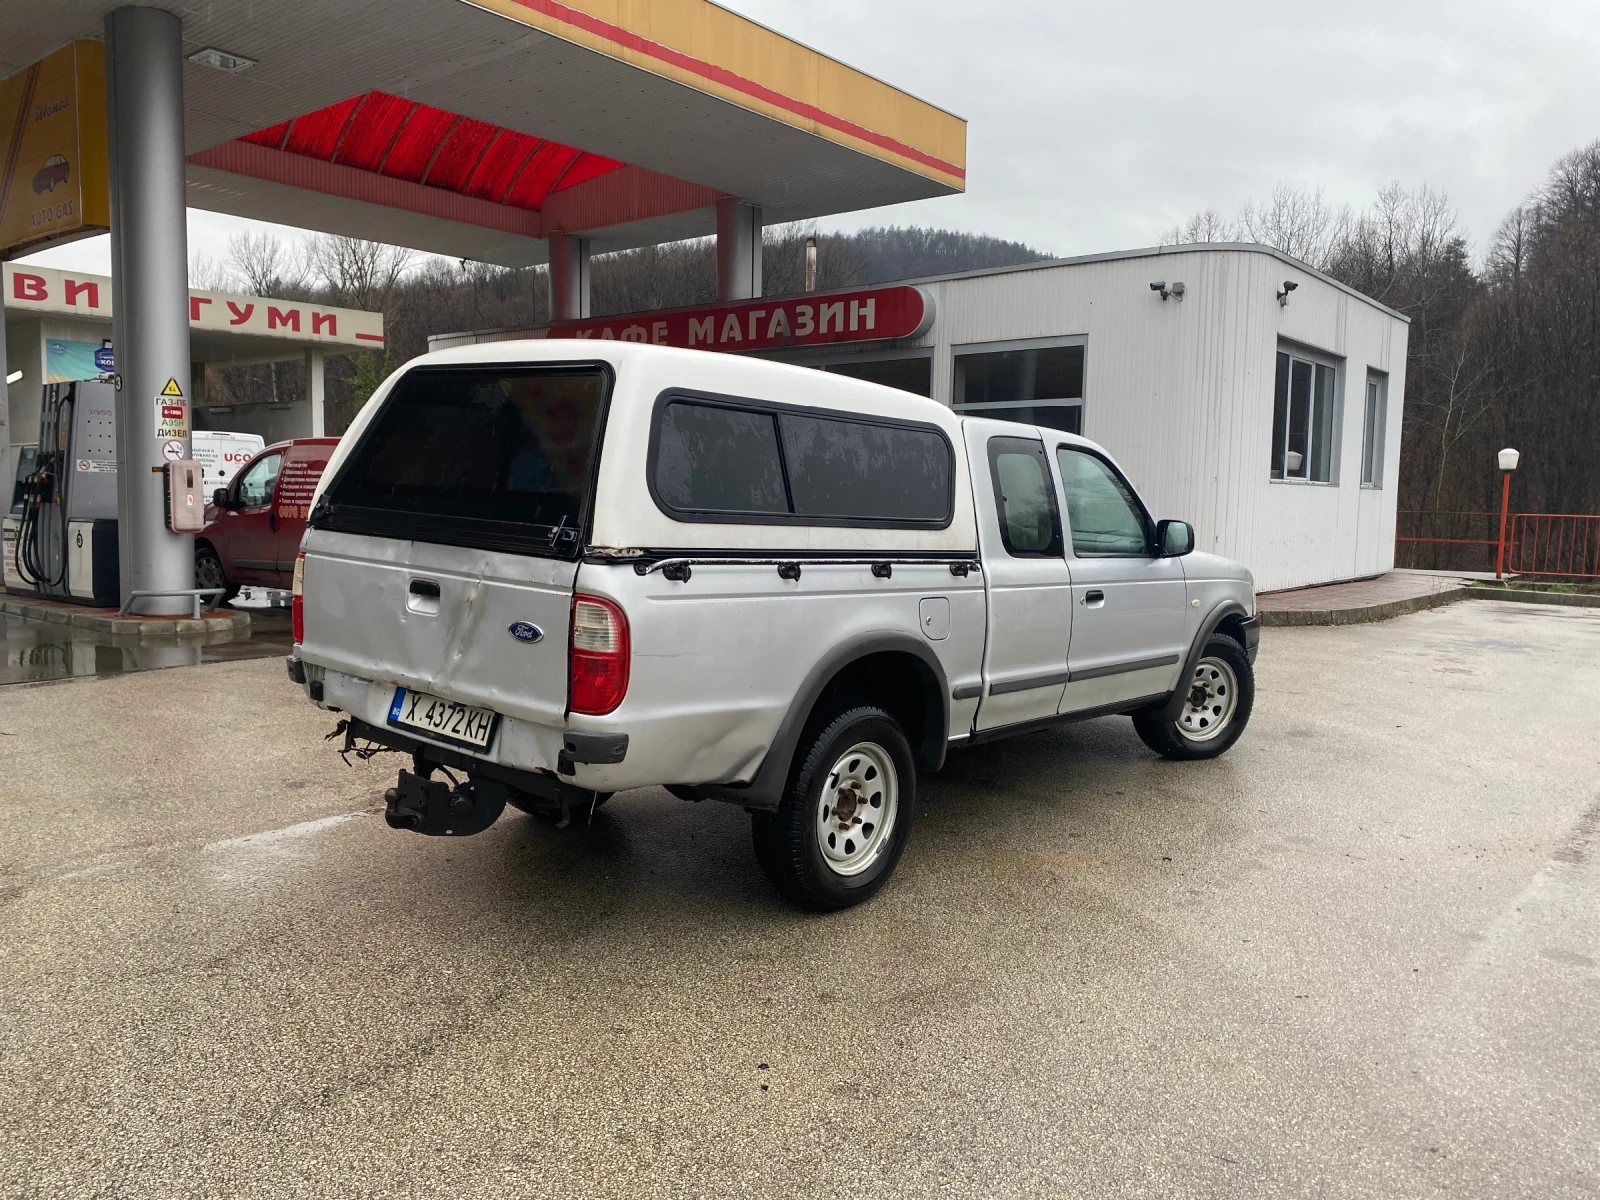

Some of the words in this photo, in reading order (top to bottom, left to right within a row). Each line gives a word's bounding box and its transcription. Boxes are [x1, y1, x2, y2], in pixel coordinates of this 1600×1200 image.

[30, 207, 53, 227] AUTO
[56, 200, 73, 219] GAS
[190, 296, 337, 336] ГУМИ
[688, 298, 876, 345] МАГАЗИН
[156, 398, 187, 406] ГАЗ-ПБ
[157, 429, 187, 438] ДИЗЕЛ
[224, 453, 253, 463] UCO
[514, 625, 534, 639] Ford
